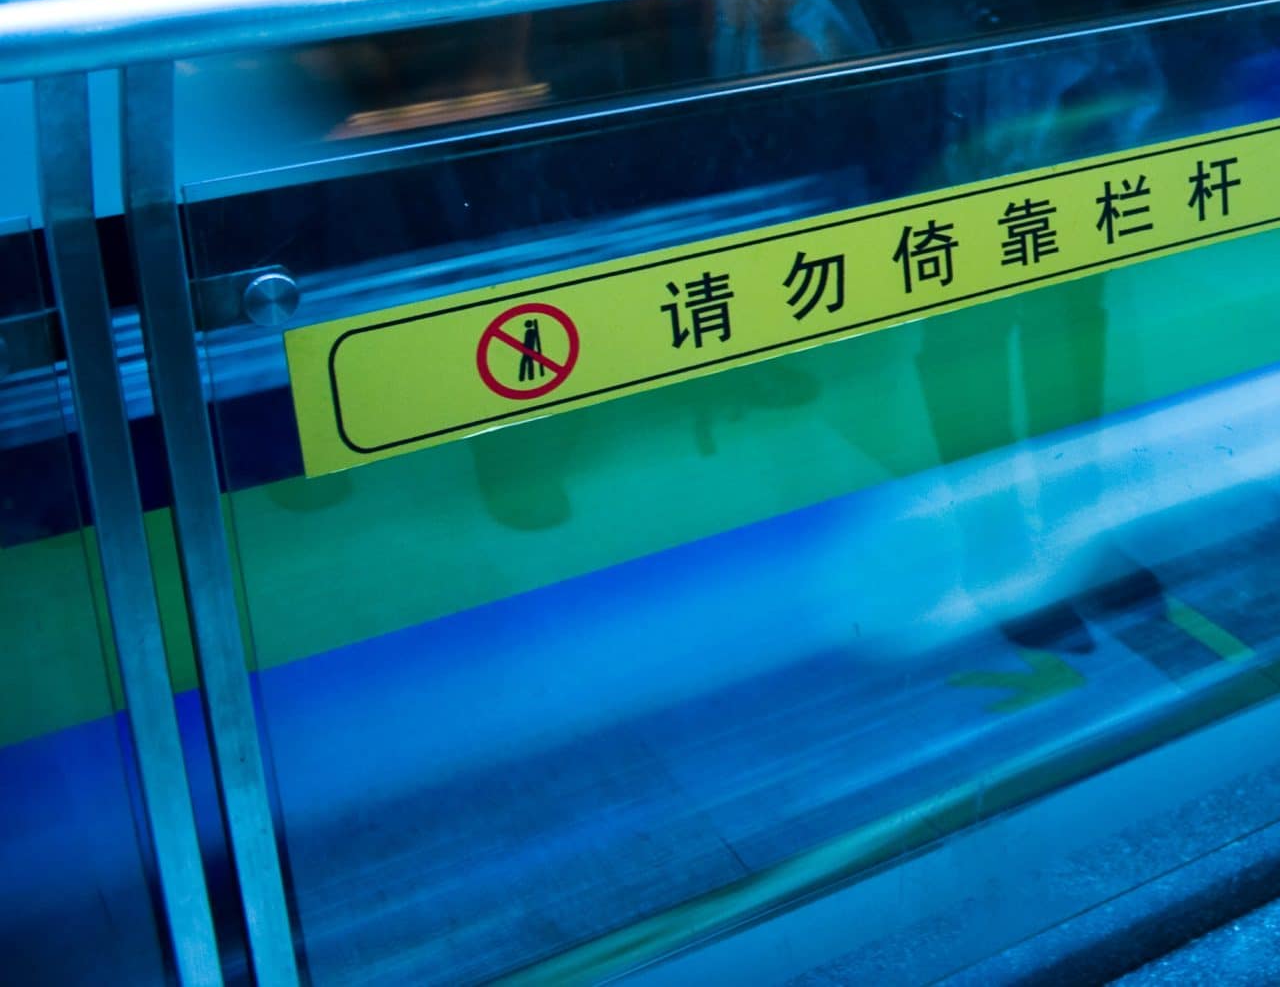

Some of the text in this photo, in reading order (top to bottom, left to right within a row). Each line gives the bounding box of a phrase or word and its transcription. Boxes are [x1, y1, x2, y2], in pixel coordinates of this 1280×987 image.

[661, 156, 1242, 349] 请勿倚靠栏杆
